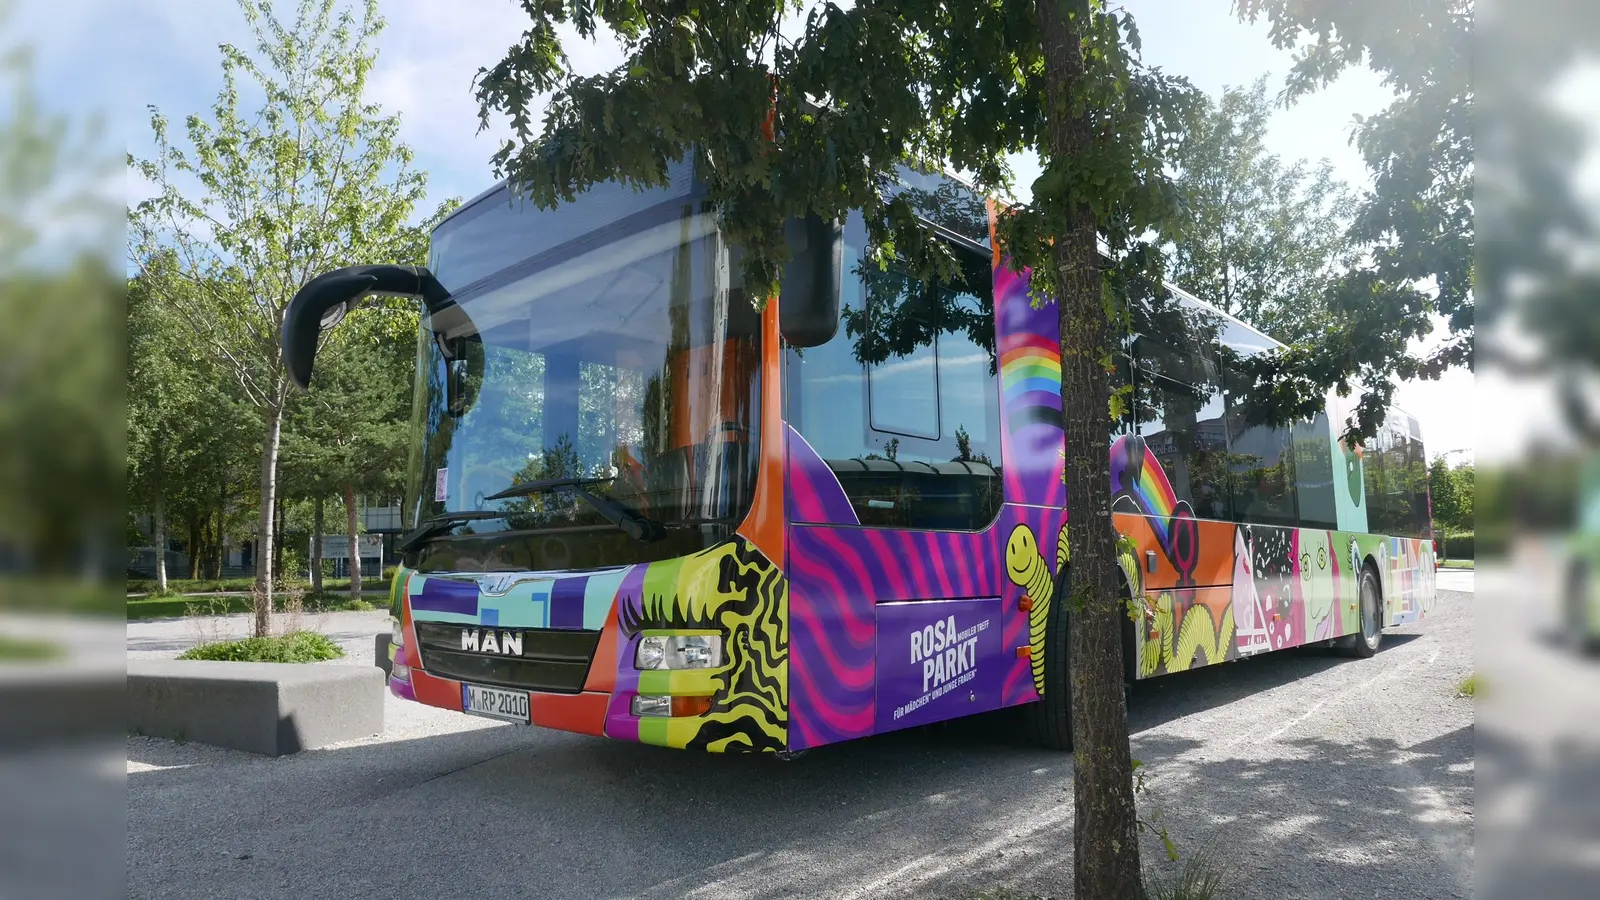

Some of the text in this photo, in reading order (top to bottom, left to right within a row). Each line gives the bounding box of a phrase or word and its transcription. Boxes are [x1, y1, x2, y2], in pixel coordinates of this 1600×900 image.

[461, 629, 523, 656] MAN
[911, 615, 958, 665] ROSA
[958, 619, 990, 641] MOBILER TREFF
[923, 636, 978, 693] PARKT
[468, 688, 527, 716] M RP 2010
[893, 706, 904, 720] FÜR
[932, 687, 942, 700] UND
[943, 679, 957, 694] JUNGE
